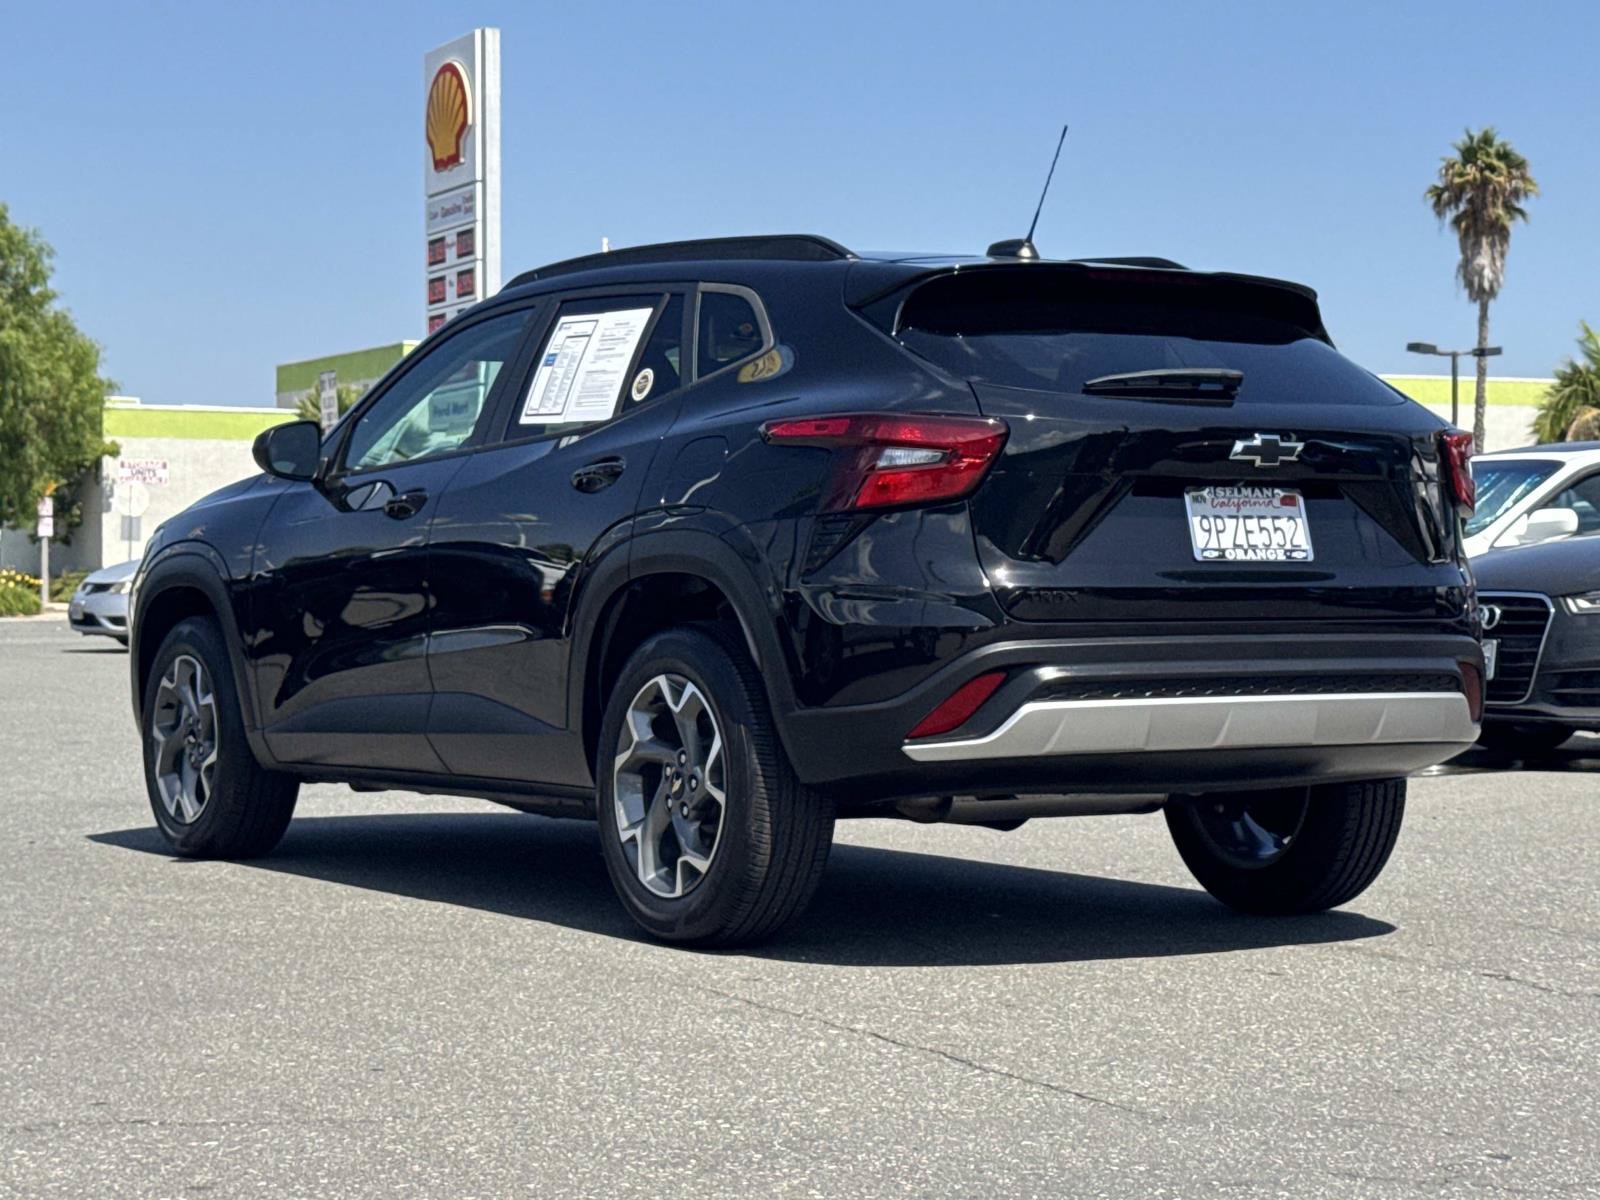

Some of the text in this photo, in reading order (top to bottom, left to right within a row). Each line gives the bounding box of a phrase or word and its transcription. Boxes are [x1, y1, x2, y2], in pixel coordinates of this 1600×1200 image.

[1215, 487, 1273, 499] SELMAN
[1211, 497, 1277, 513] California
[1199, 514, 1303, 548] 9PZE552
[1225, 548, 1287, 560] ORANGE
